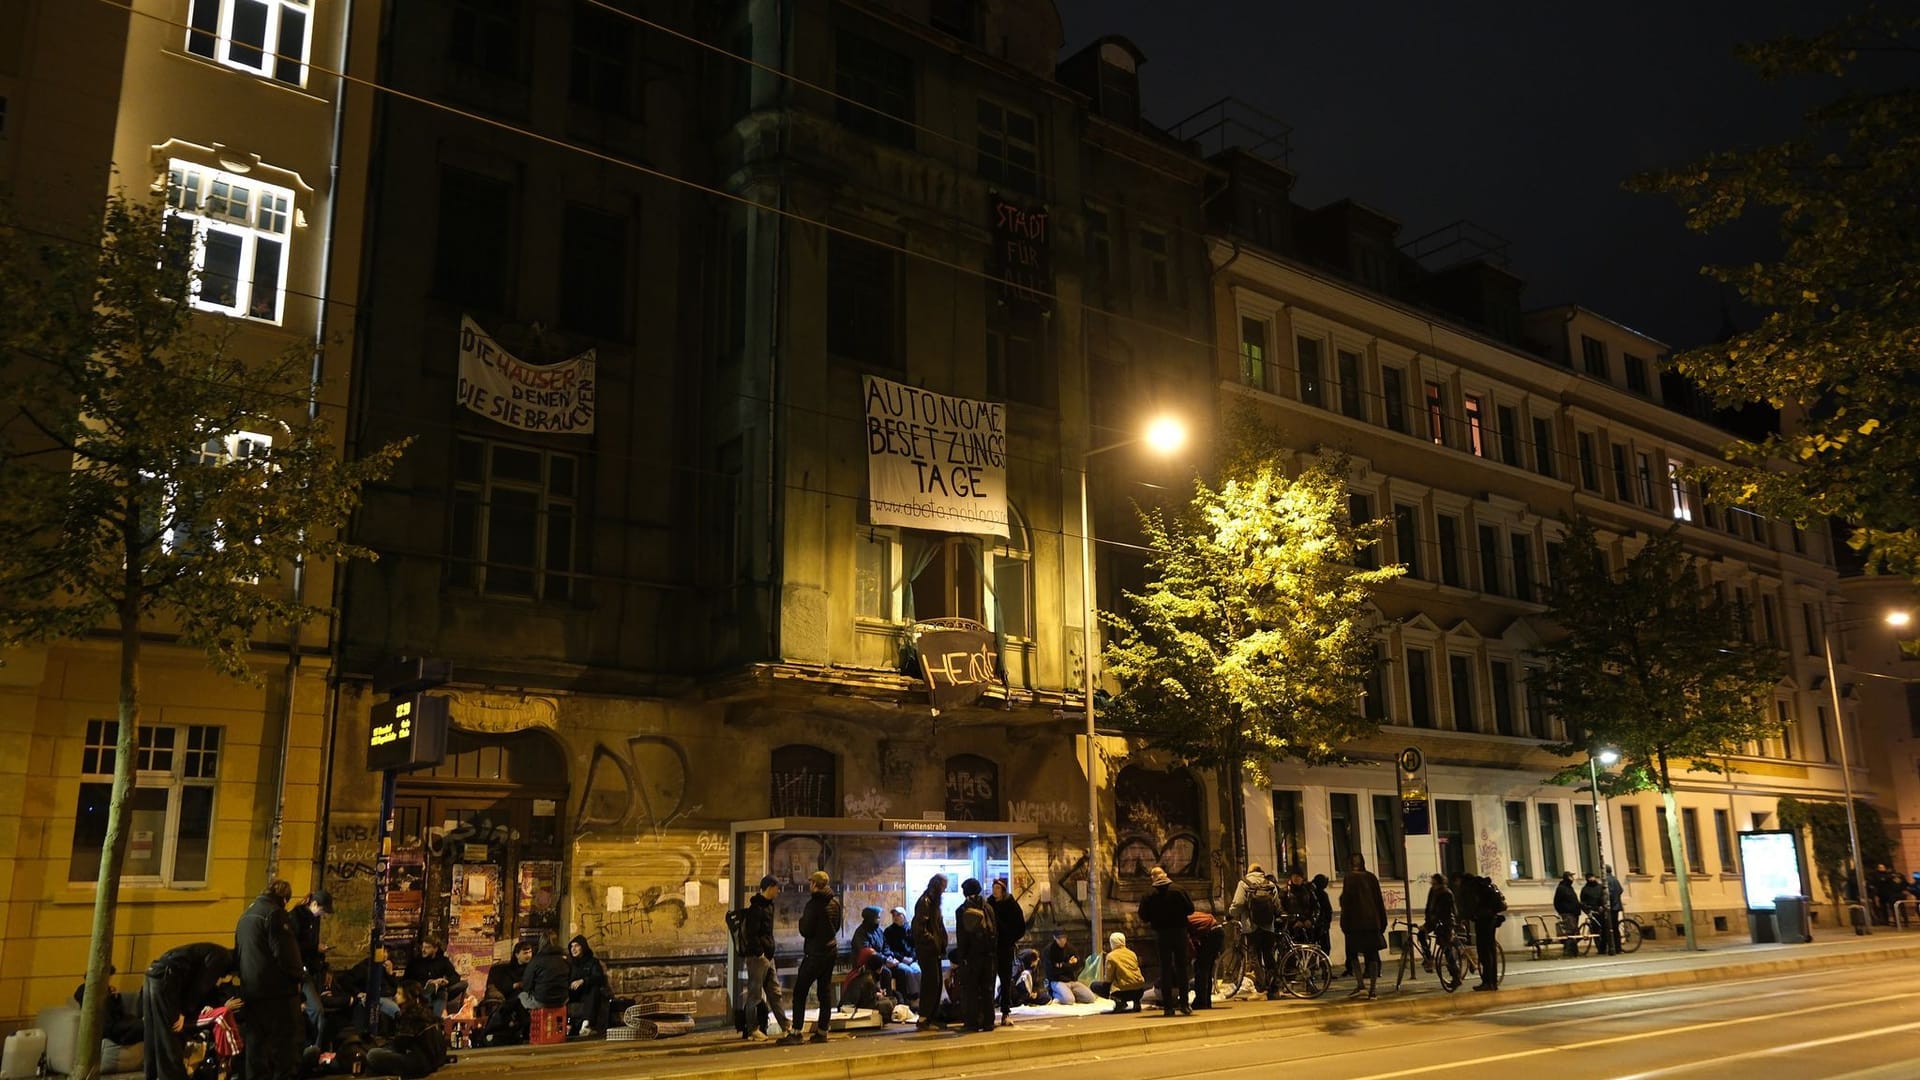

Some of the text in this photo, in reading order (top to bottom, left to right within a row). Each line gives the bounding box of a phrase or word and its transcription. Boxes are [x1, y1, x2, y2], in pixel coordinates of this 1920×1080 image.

[995, 201, 1048, 244] STADT
[462, 326, 495, 367] DIE
[458, 378, 489, 411] DIE
[490, 396, 522, 426] SIE
[511, 385, 571, 408] DENEN
[867, 379, 1002, 433] AUTONOME
[910, 460, 987, 498] TAGE
[893, 821, 947, 831] Henriettenstraße
